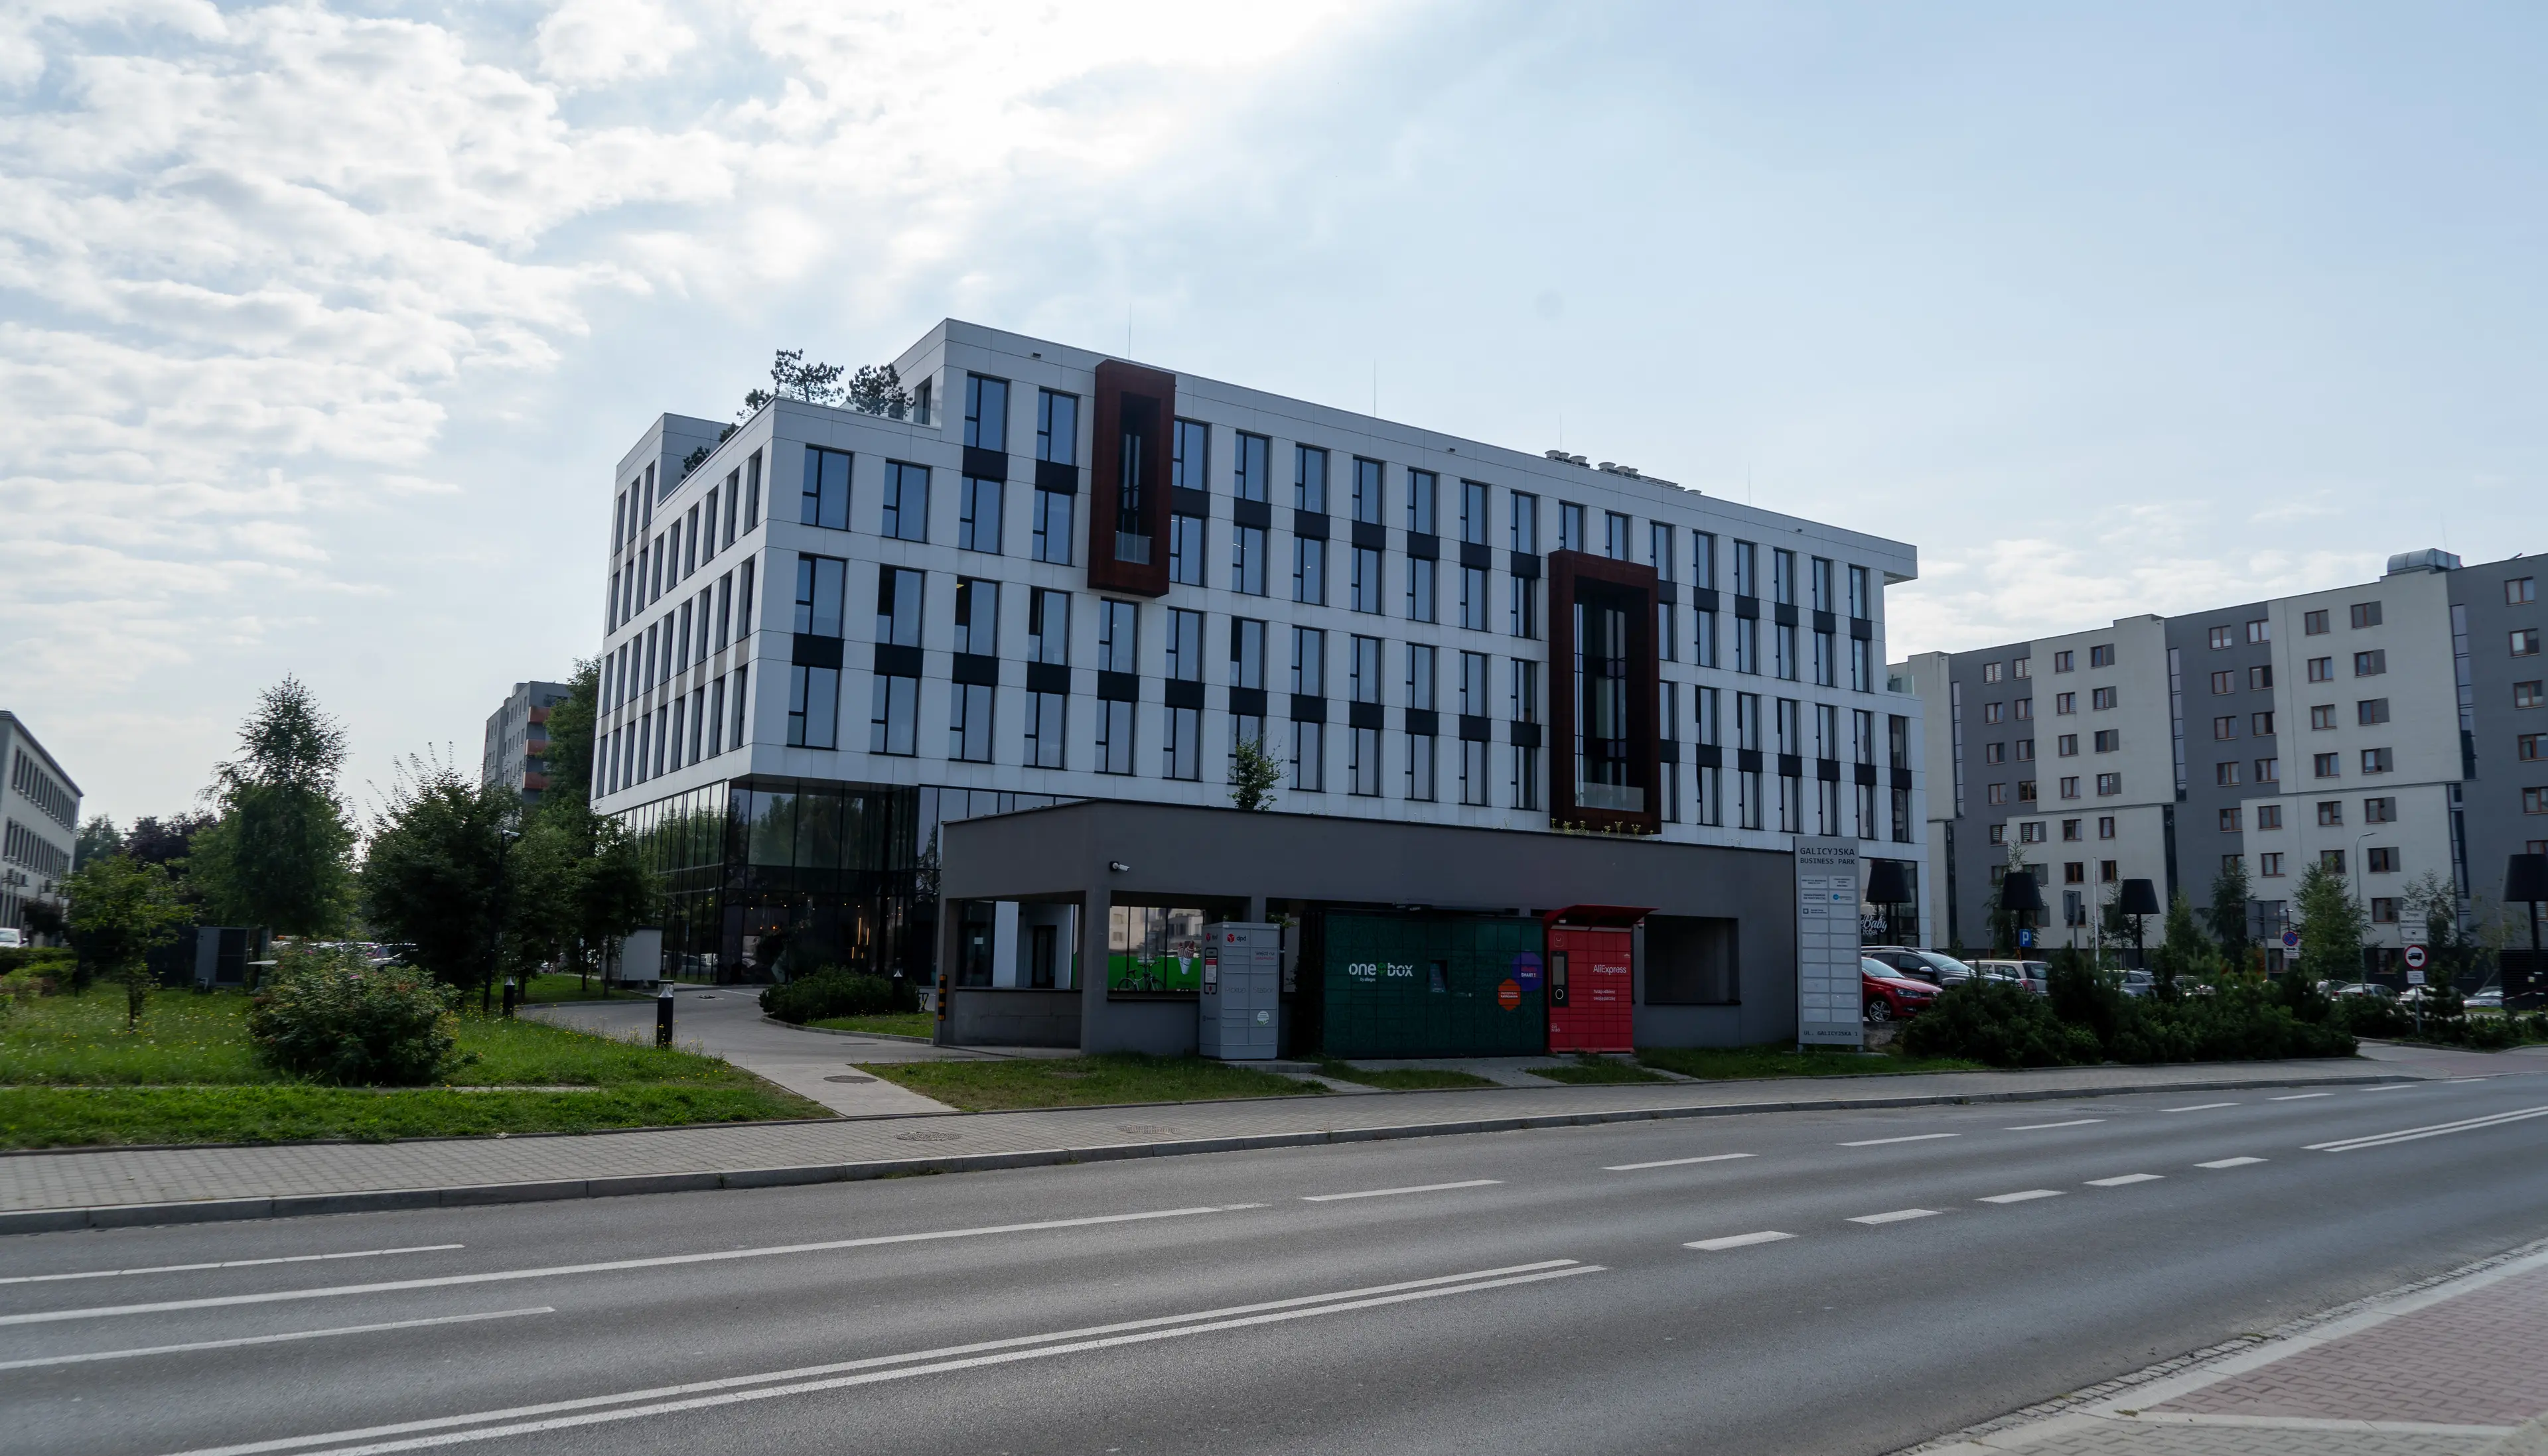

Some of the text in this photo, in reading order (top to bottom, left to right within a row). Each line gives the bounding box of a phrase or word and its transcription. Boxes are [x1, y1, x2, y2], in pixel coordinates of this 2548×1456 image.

[2022, 931, 2029, 945] P
[1349, 962, 1413, 976] one box
[1593, 964, 1627, 976] AliExpress
